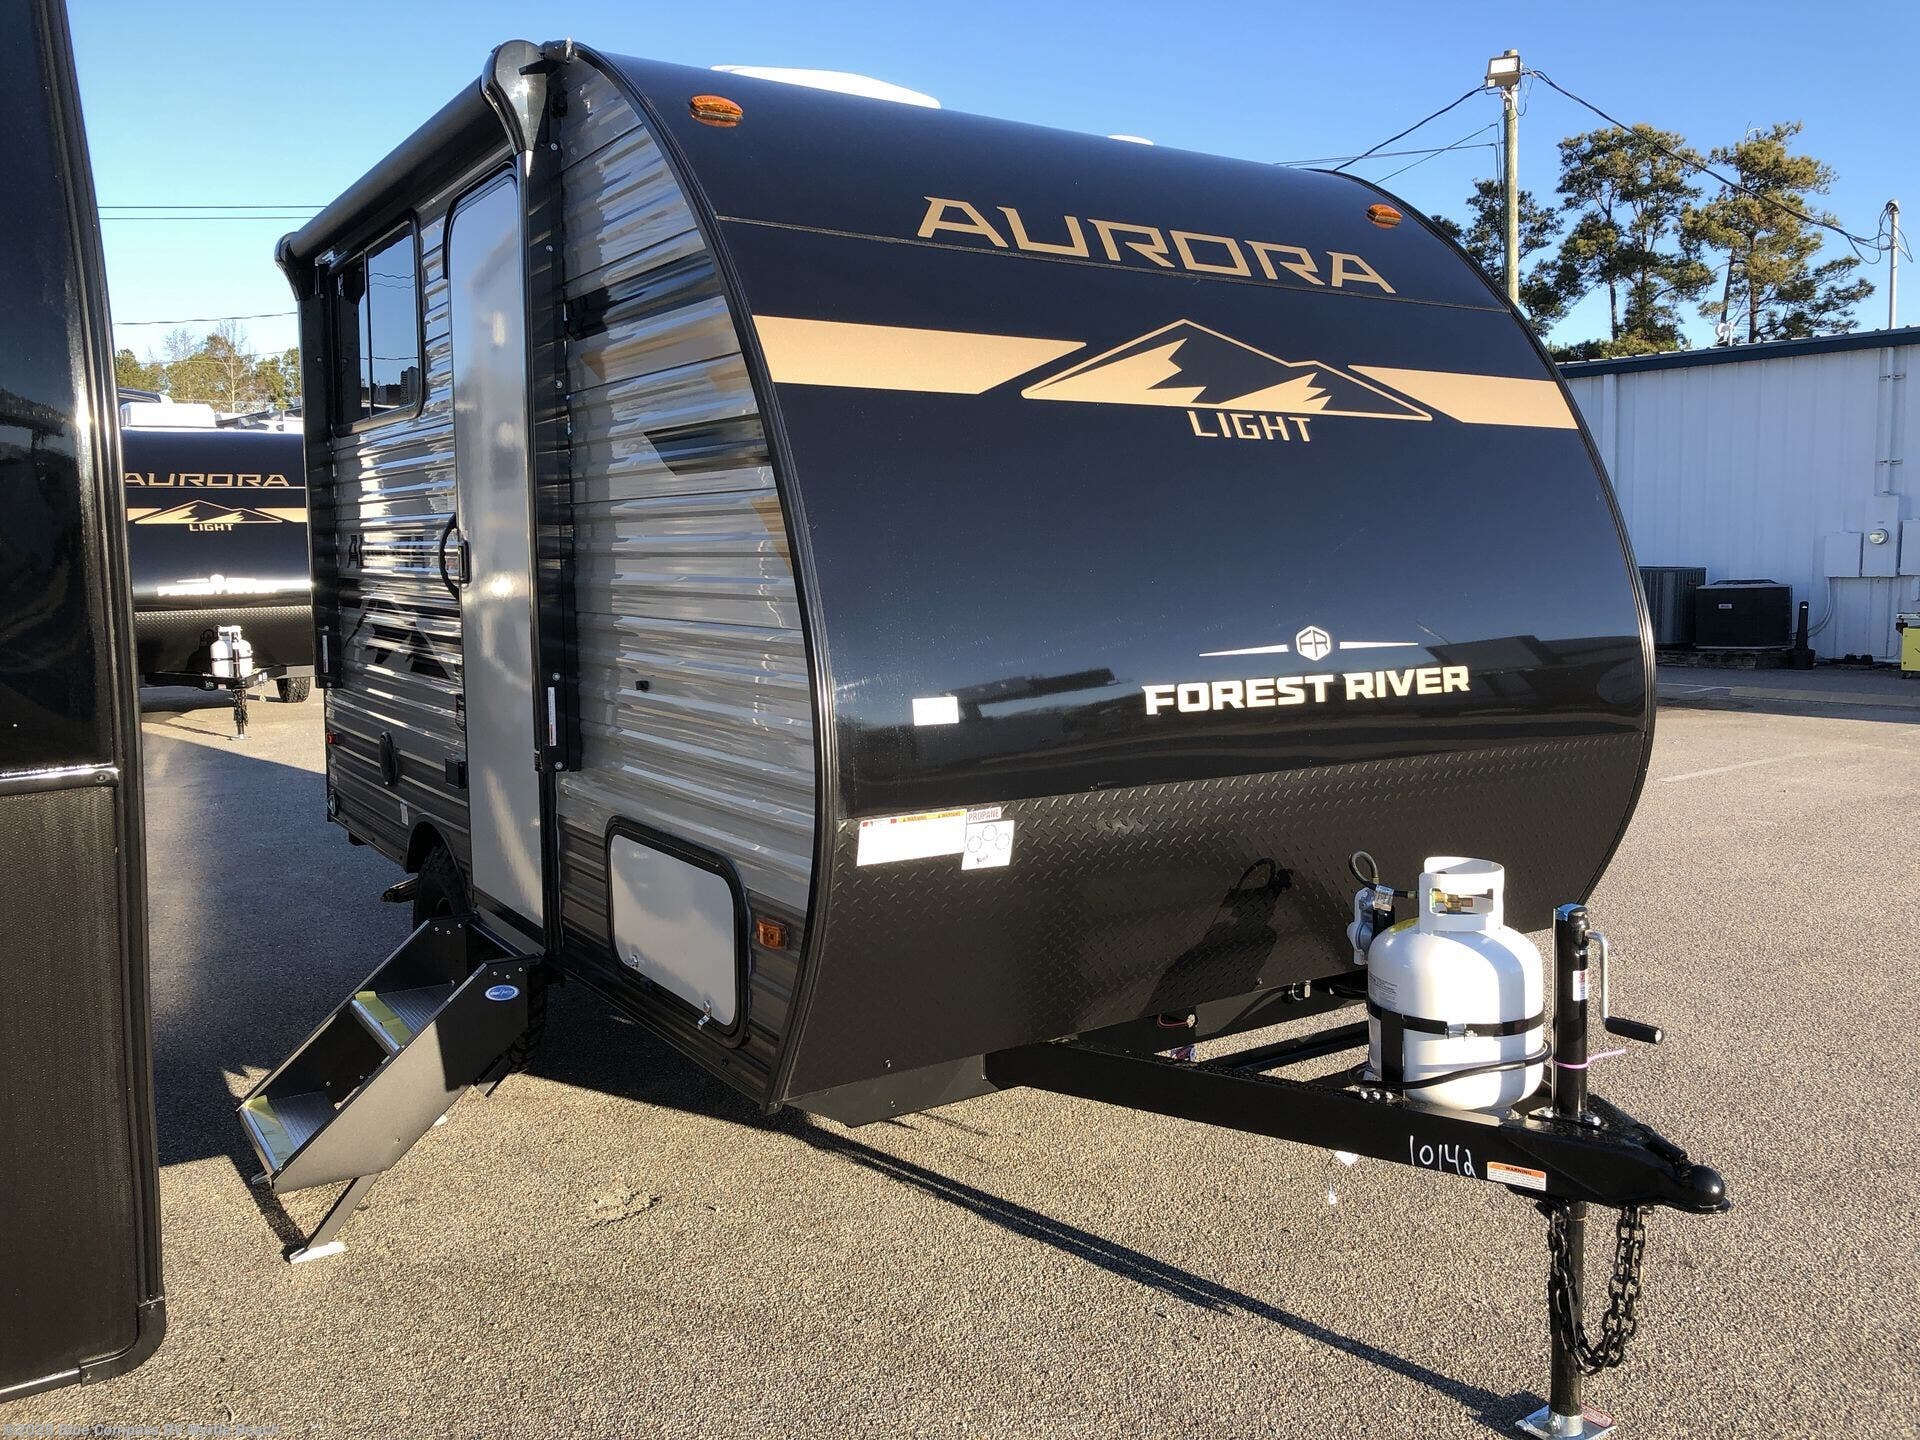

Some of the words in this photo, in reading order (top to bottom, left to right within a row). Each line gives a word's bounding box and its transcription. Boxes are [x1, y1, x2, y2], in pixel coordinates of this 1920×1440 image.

[917, 196, 1396, 294] AURORA
[1187, 410, 1312, 442] LIGHT
[125, 472, 290, 487] AURORA
[189, 523, 234, 532] LIGHT
[1141, 674, 1334, 716] FOREST
[1342, 665, 1470, 701] RIVER
[968, 810, 1000, 822] PROPANE
[1409, 1135, 1477, 1178] 10142
[1505, 1166, 1532, 1175] WARNING
